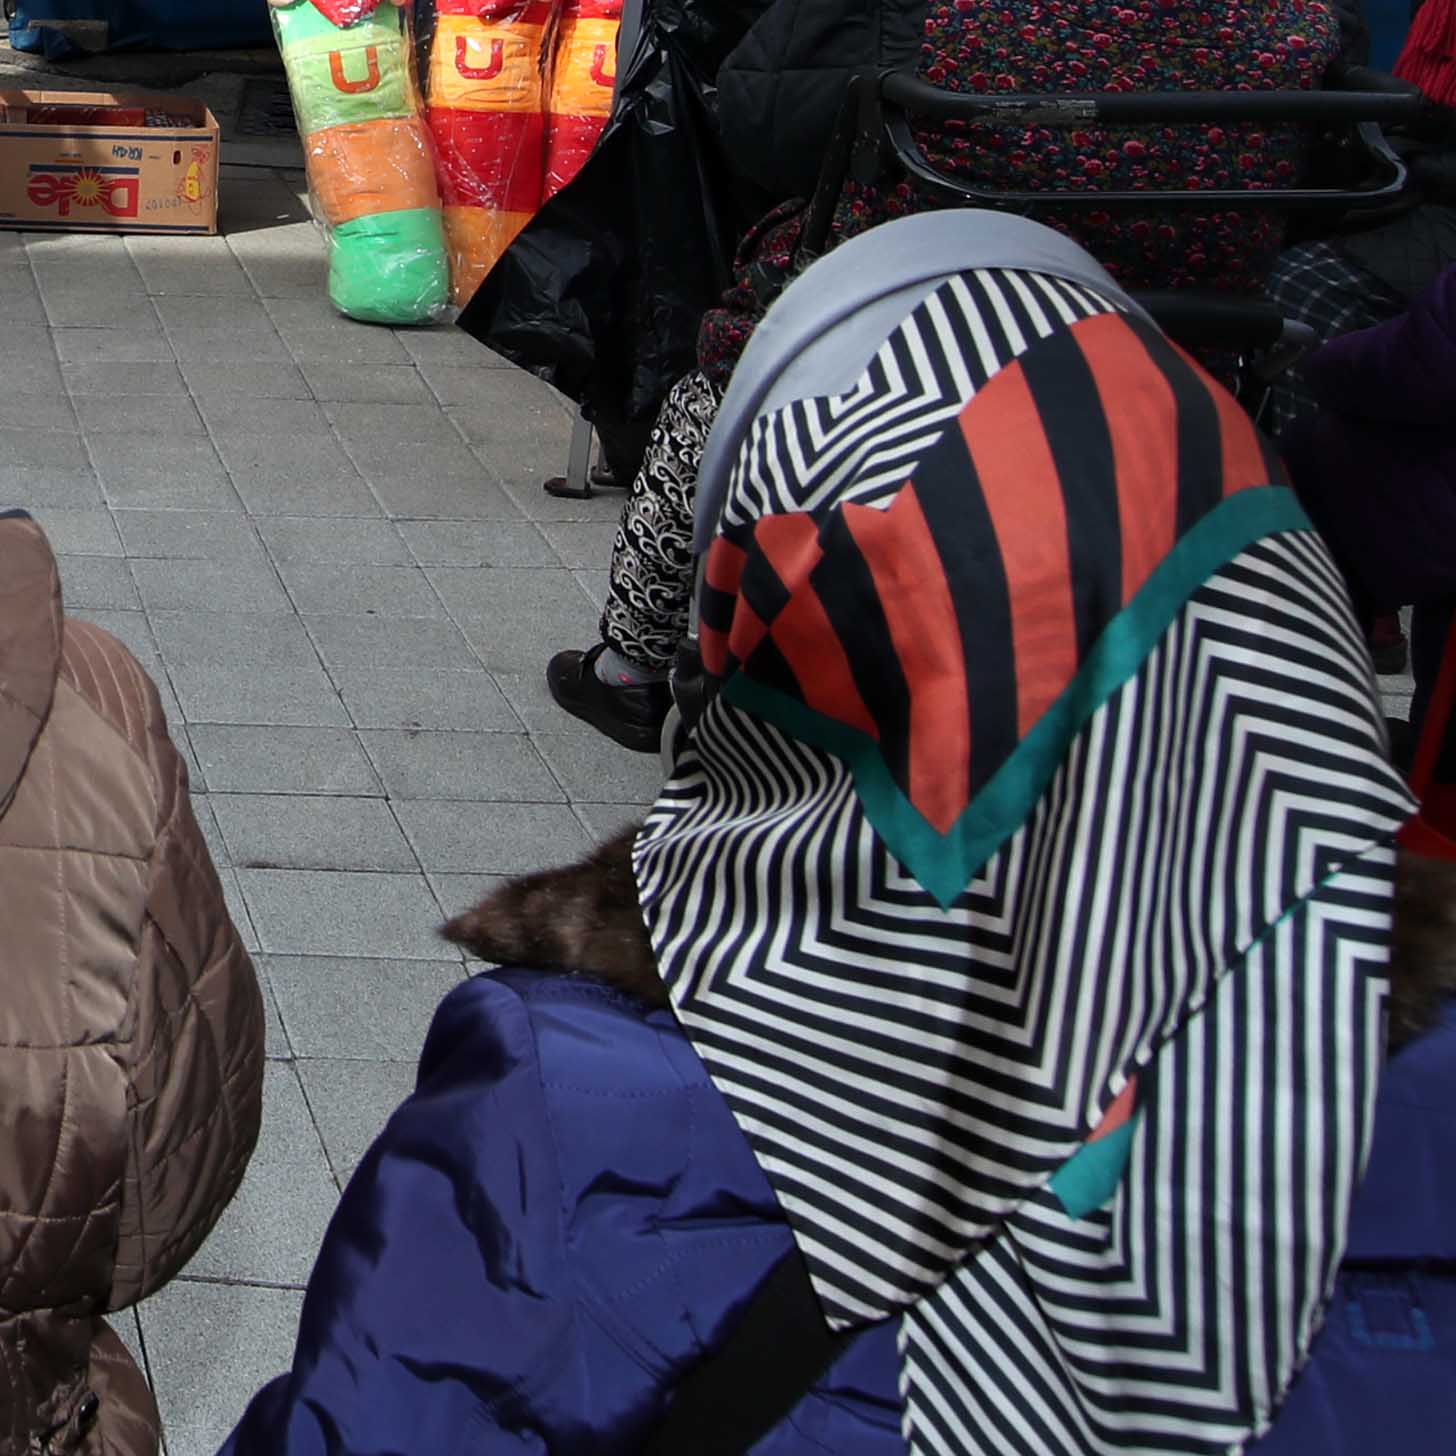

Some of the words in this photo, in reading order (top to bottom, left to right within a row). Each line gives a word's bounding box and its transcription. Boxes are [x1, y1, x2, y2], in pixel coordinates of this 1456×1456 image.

[328, 46, 381, 94] U
[455, 35, 504, 80] U
[25, 170, 140, 219] Dole
